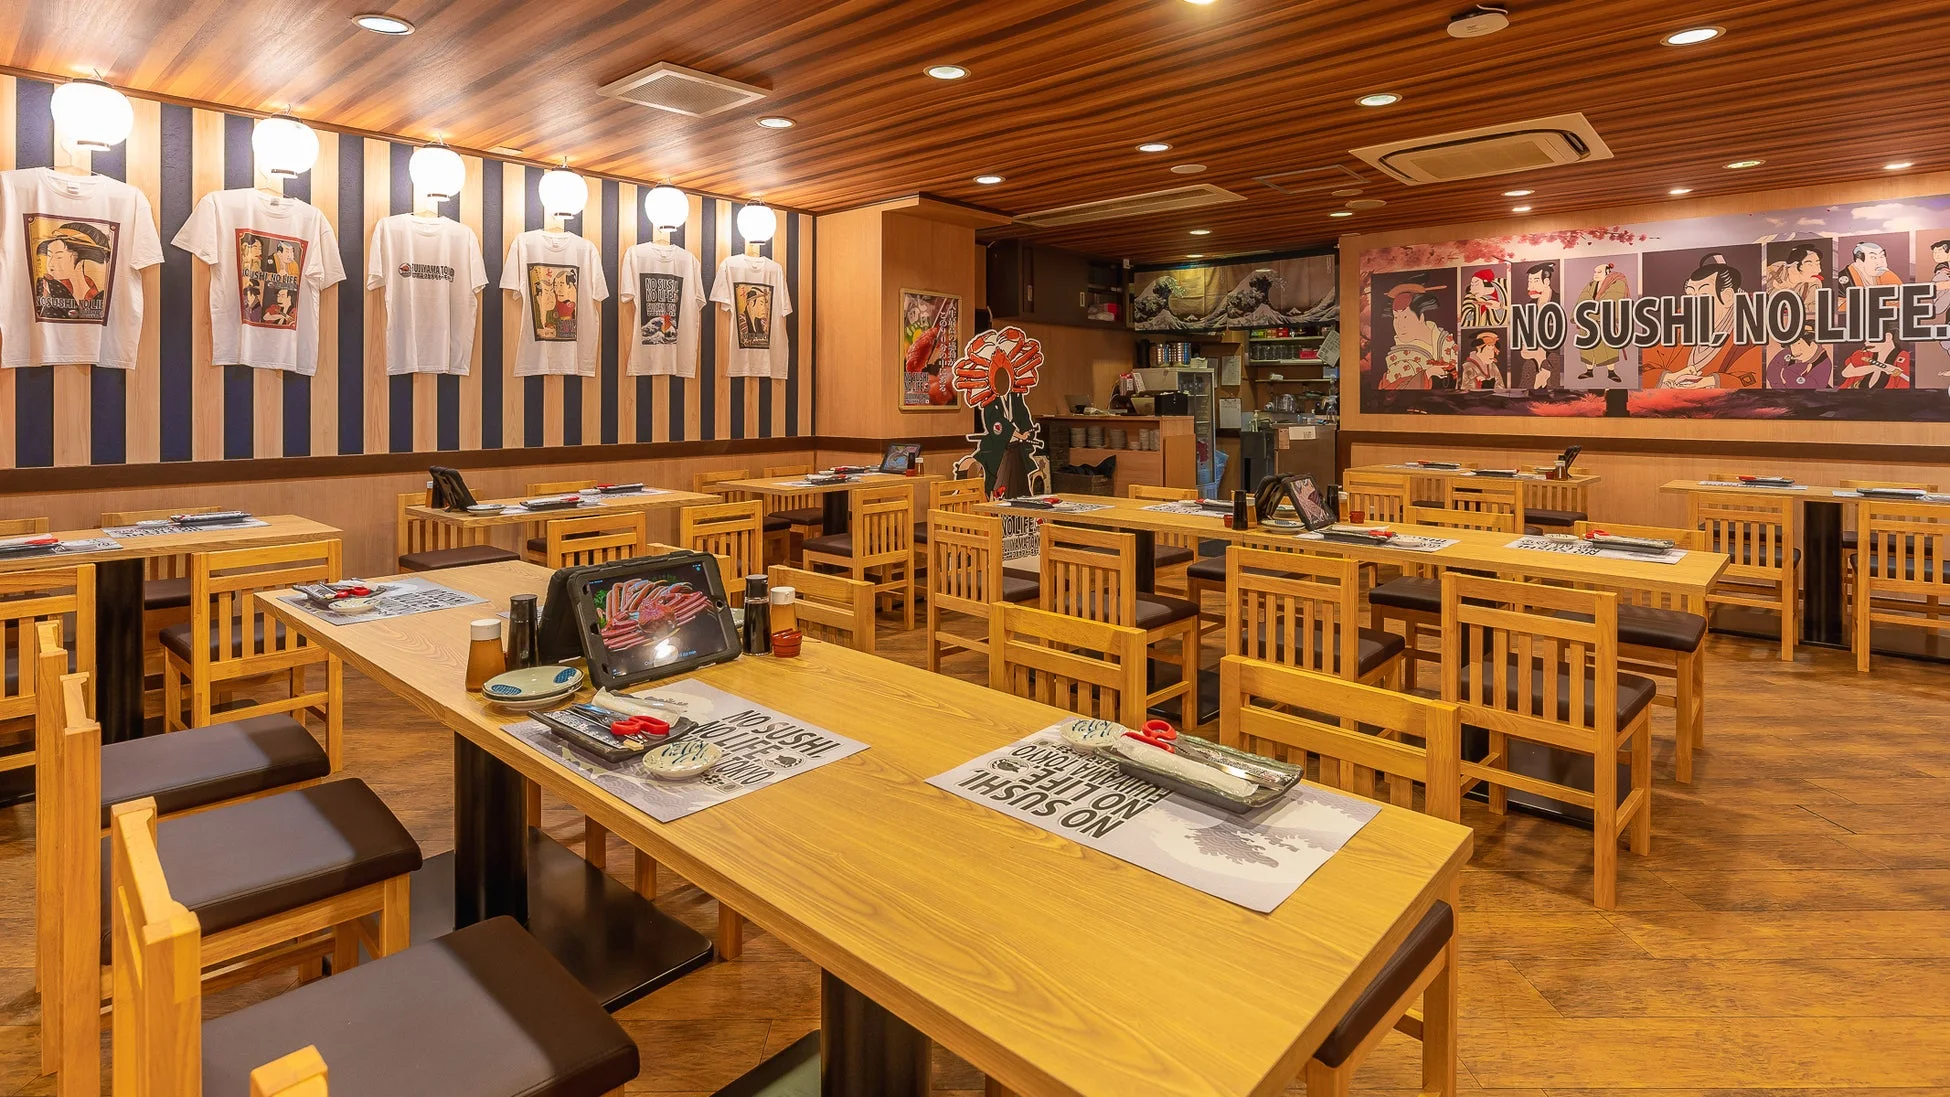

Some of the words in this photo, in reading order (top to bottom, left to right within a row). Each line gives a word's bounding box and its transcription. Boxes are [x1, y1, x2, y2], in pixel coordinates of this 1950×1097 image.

[645, 277, 657, 290] NO
[1510, 301, 1567, 350] NO
[1573, 295, 1728, 349] SUSHI,
[1733, 289, 1806, 345] NO
[1815, 282, 1950, 343] LIFE.
[691, 720, 737, 739] NO
[721, 709, 772, 728] NO
[751, 721, 841, 759] SUSHI,
[712, 756, 776, 785] TOKYO
[1012, 745, 1079, 772] TOKYO
[958, 769, 1072, 817] SUSHI,
[1074, 763, 1173, 804] FUJIYAMA
[1092, 793, 1152, 820] NO
[1060, 809, 1124, 839] NO
